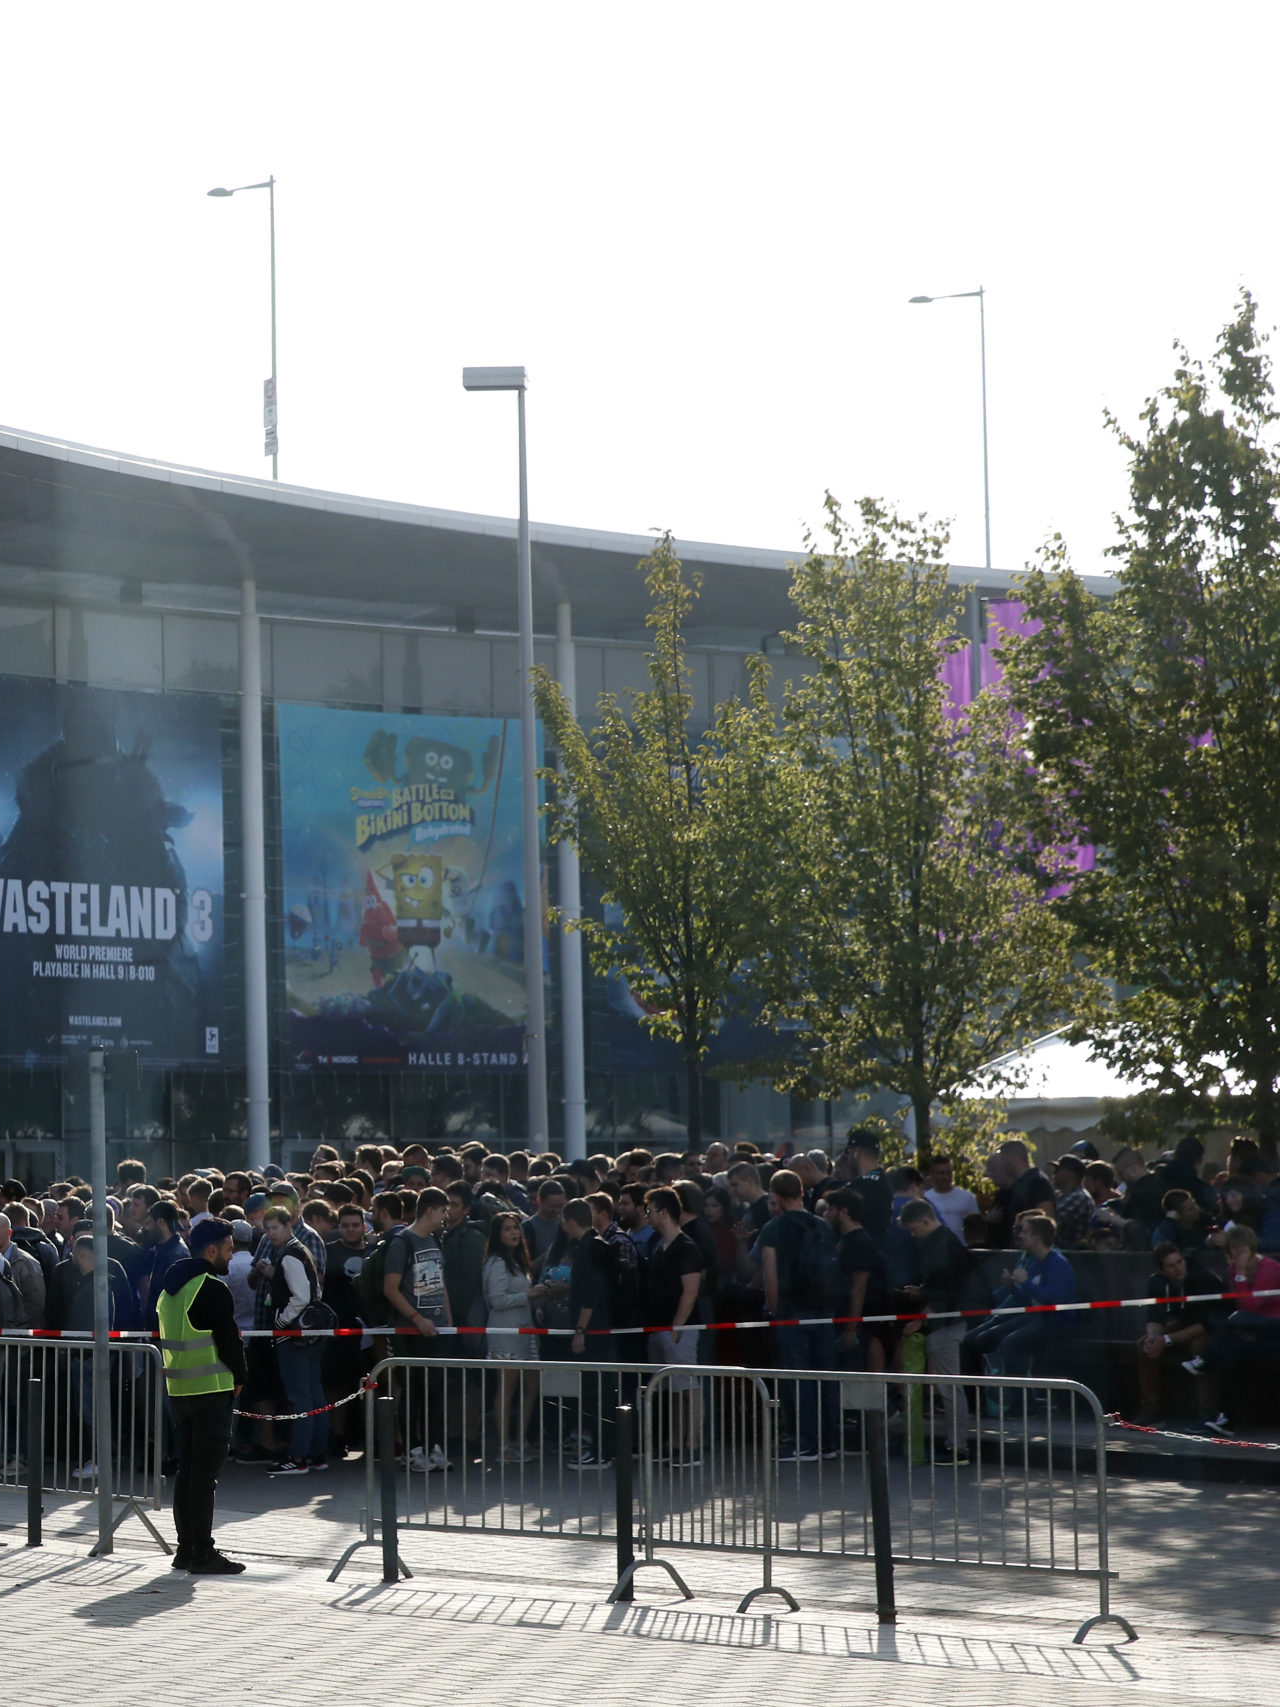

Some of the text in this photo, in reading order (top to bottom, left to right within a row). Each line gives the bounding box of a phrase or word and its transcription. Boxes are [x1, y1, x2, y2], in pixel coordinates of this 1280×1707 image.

[392, 784, 439, 808] BATTLE
[190, 889, 214, 942] 3
[55, 944, 134, 962] WORLD PREMIERE
[33, 961, 79, 978] PLAYABLE
[81, 963, 91, 978] IN
[92, 964, 115, 979] HALL
[408, 1052, 451, 1066] HALLE
